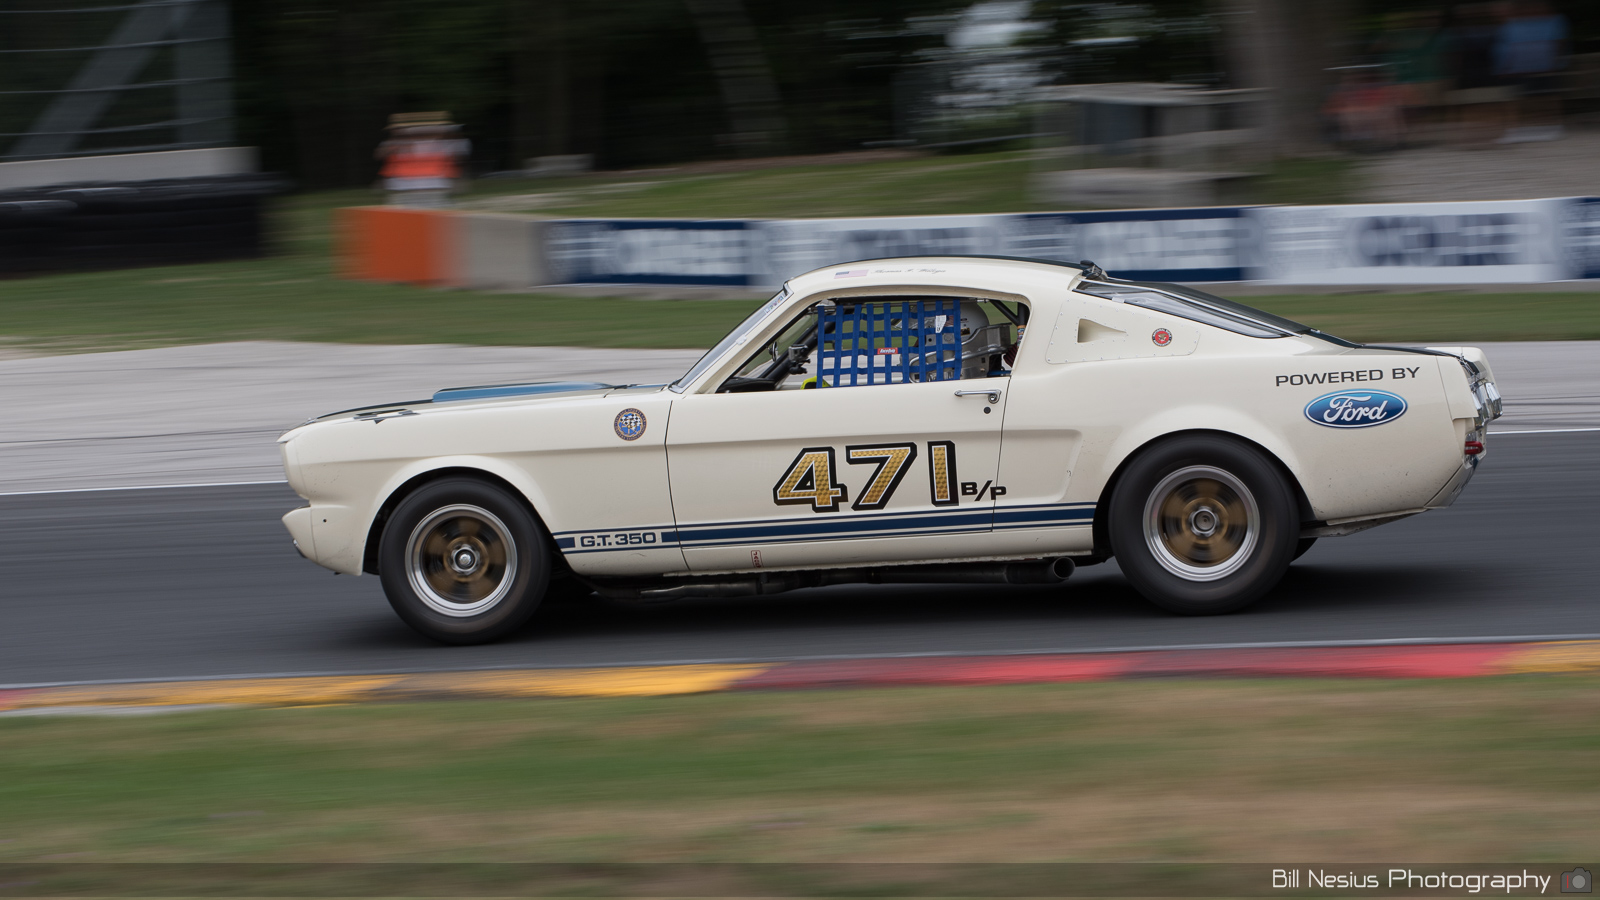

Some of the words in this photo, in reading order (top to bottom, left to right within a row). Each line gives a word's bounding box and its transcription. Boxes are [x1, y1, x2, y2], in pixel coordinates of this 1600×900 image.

[1275, 368, 1384, 387] POWERED
[1391, 366, 1421, 380] BY
[1323, 395, 1388, 423] Ford
[772, 440, 959, 513] 471
[960, 479, 1007, 502] B/P
